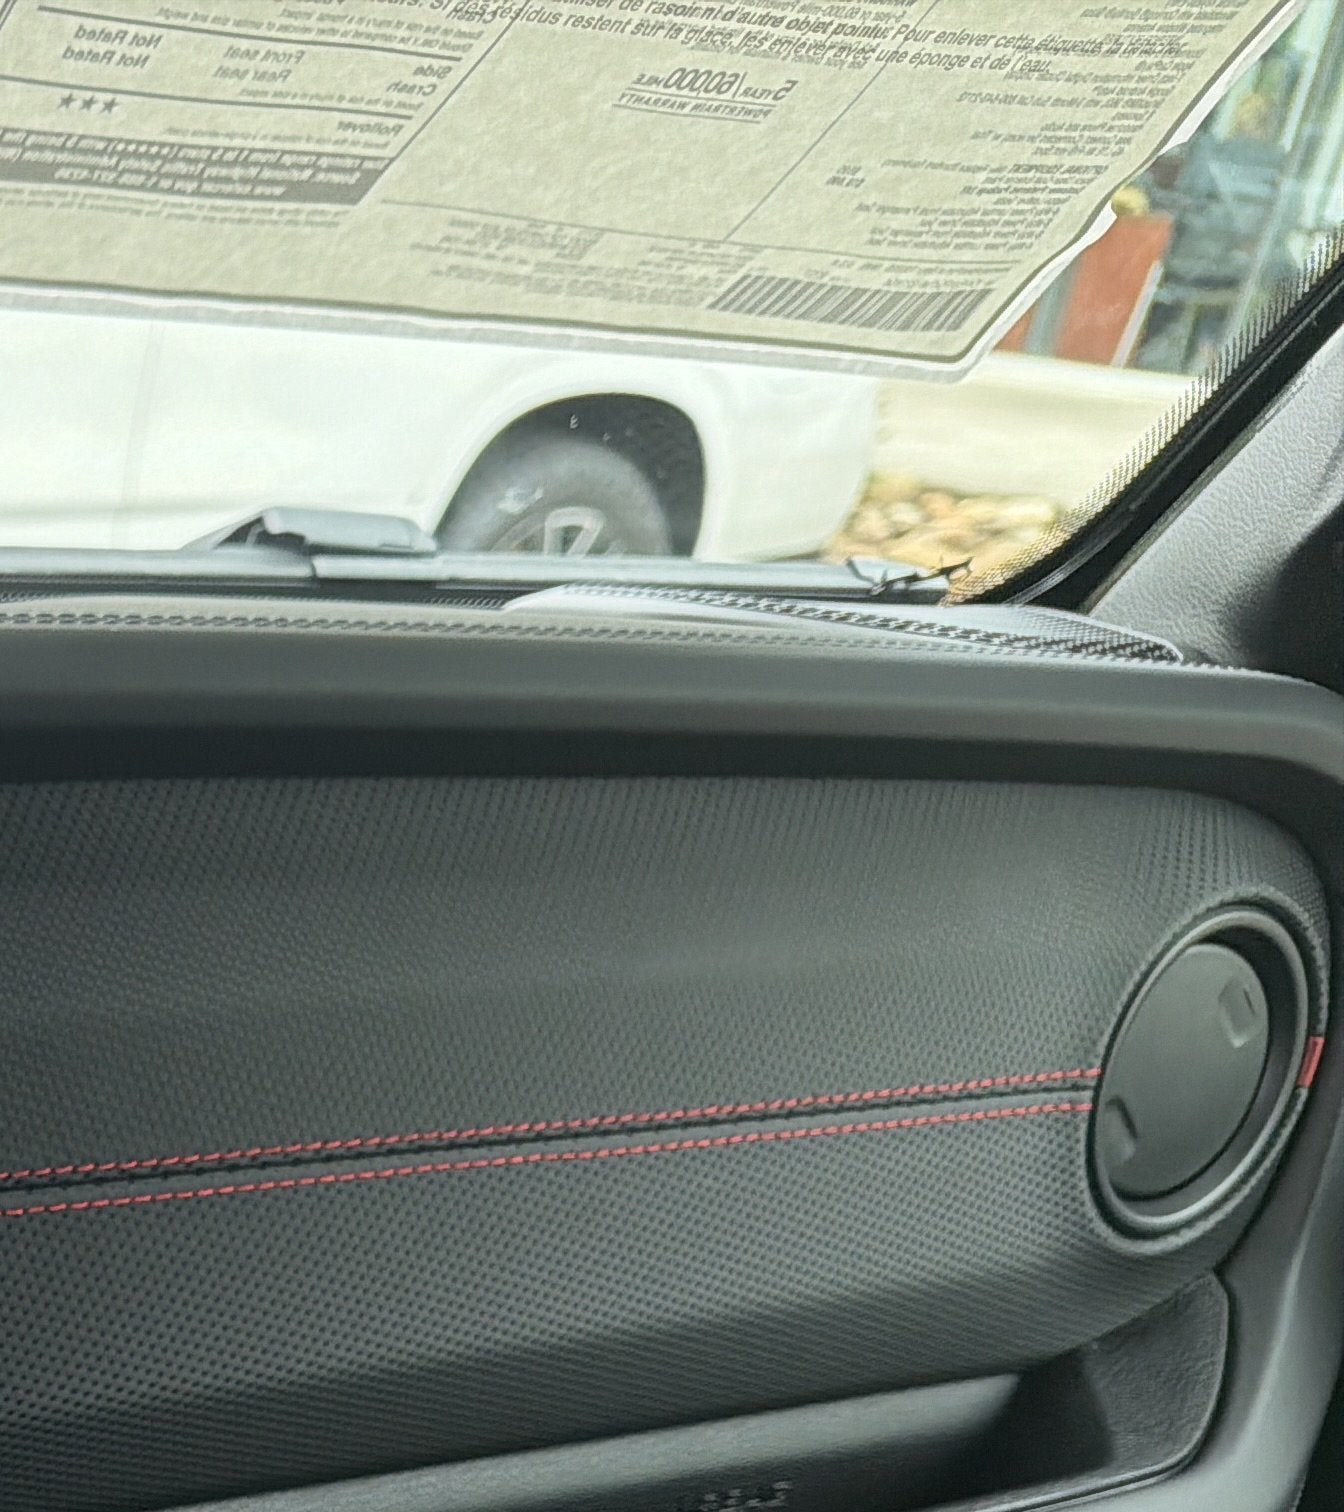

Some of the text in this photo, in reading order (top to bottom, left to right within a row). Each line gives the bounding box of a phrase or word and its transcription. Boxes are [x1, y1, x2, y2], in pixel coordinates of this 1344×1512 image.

[492, 3, 561, 27] résidus
[563, 13, 631, 36] restent
[910, 47, 970, 71] éponge
[971, 53, 990, 69] et
[990, 54, 1010, 71] de
[785, 14, 827, 42] objet
[891, 23, 931, 44] Pour
[934, 28, 993, 48] enlever
[994, 33, 1032, 50] cette
